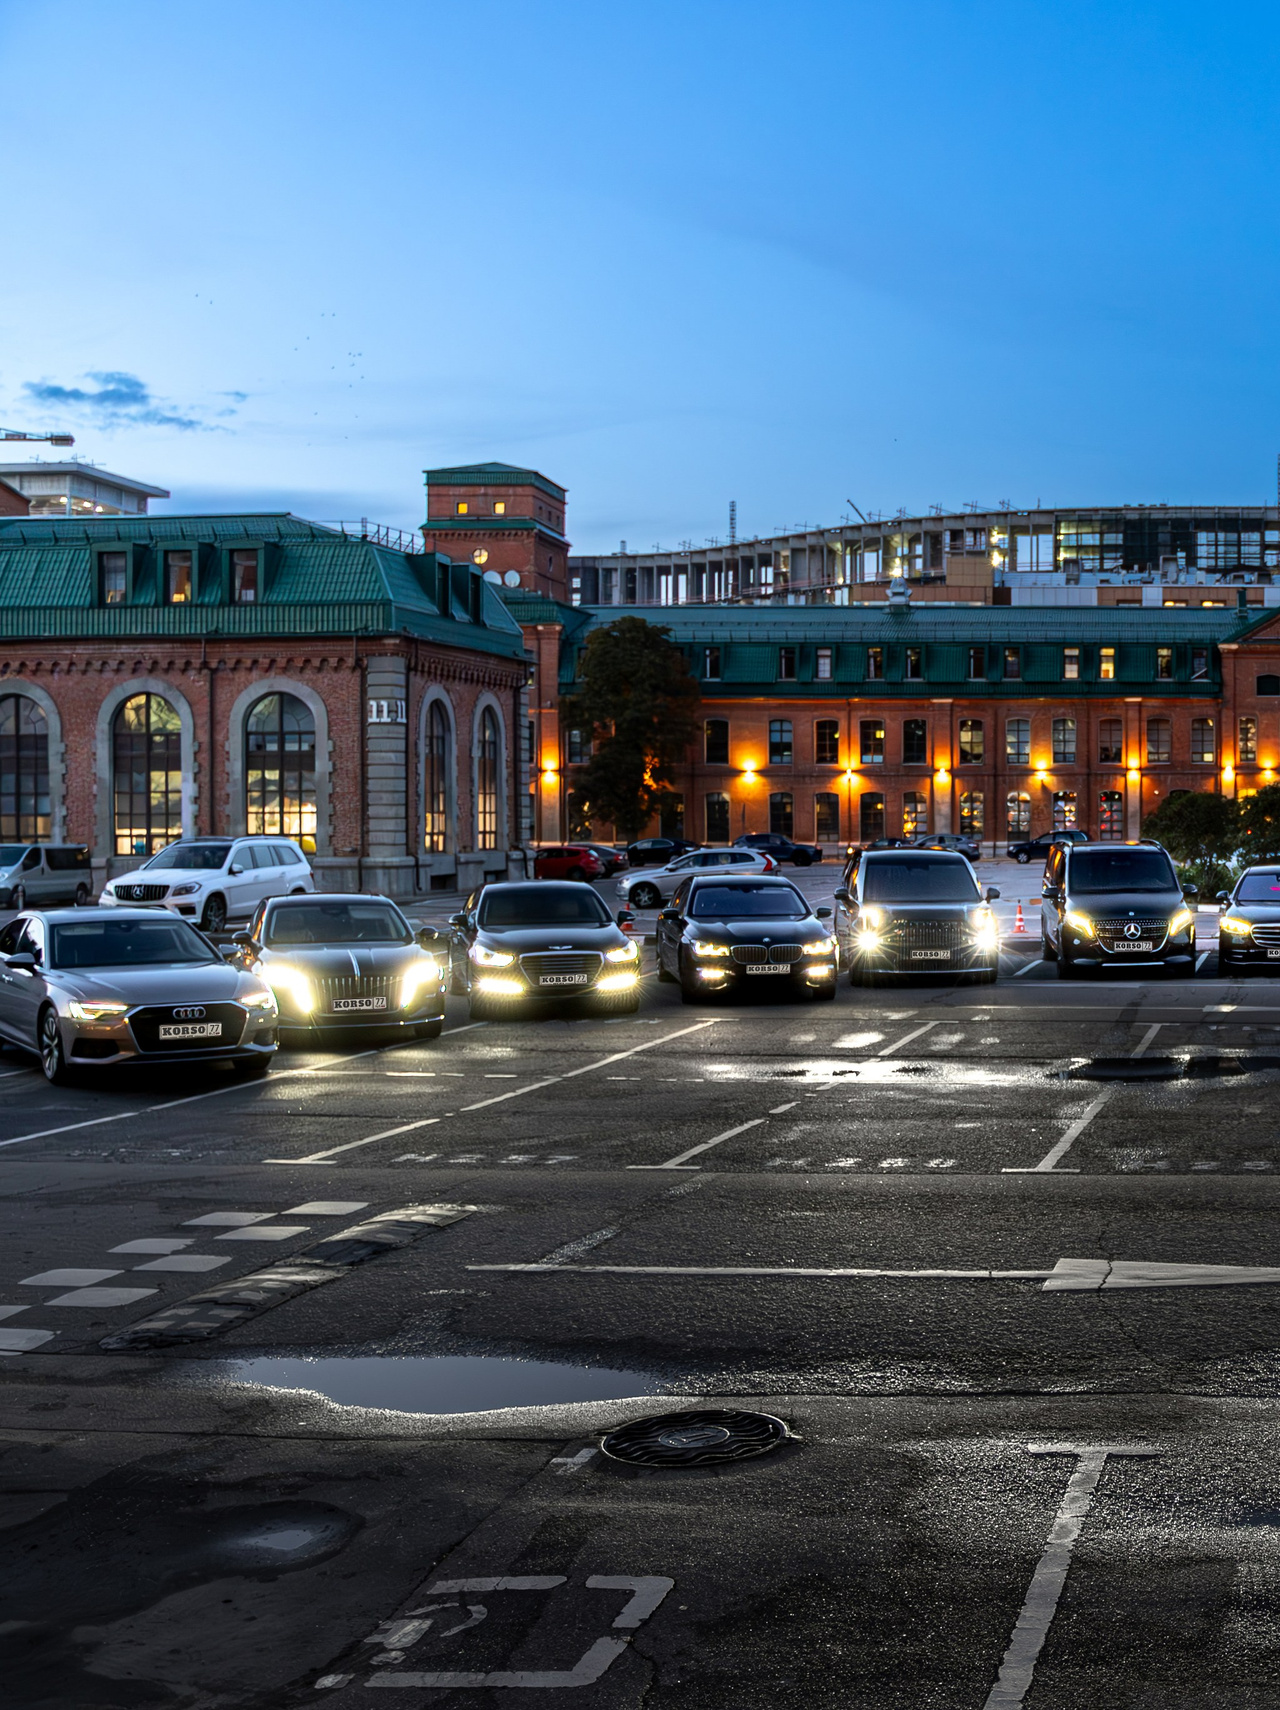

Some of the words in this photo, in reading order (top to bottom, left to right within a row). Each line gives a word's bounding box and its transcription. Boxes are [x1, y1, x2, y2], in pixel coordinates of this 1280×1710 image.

[368, 700, 391, 723] 11
[334, 1000, 371, 1008] KORSO
[162, 1026, 205, 1036] KORSO
